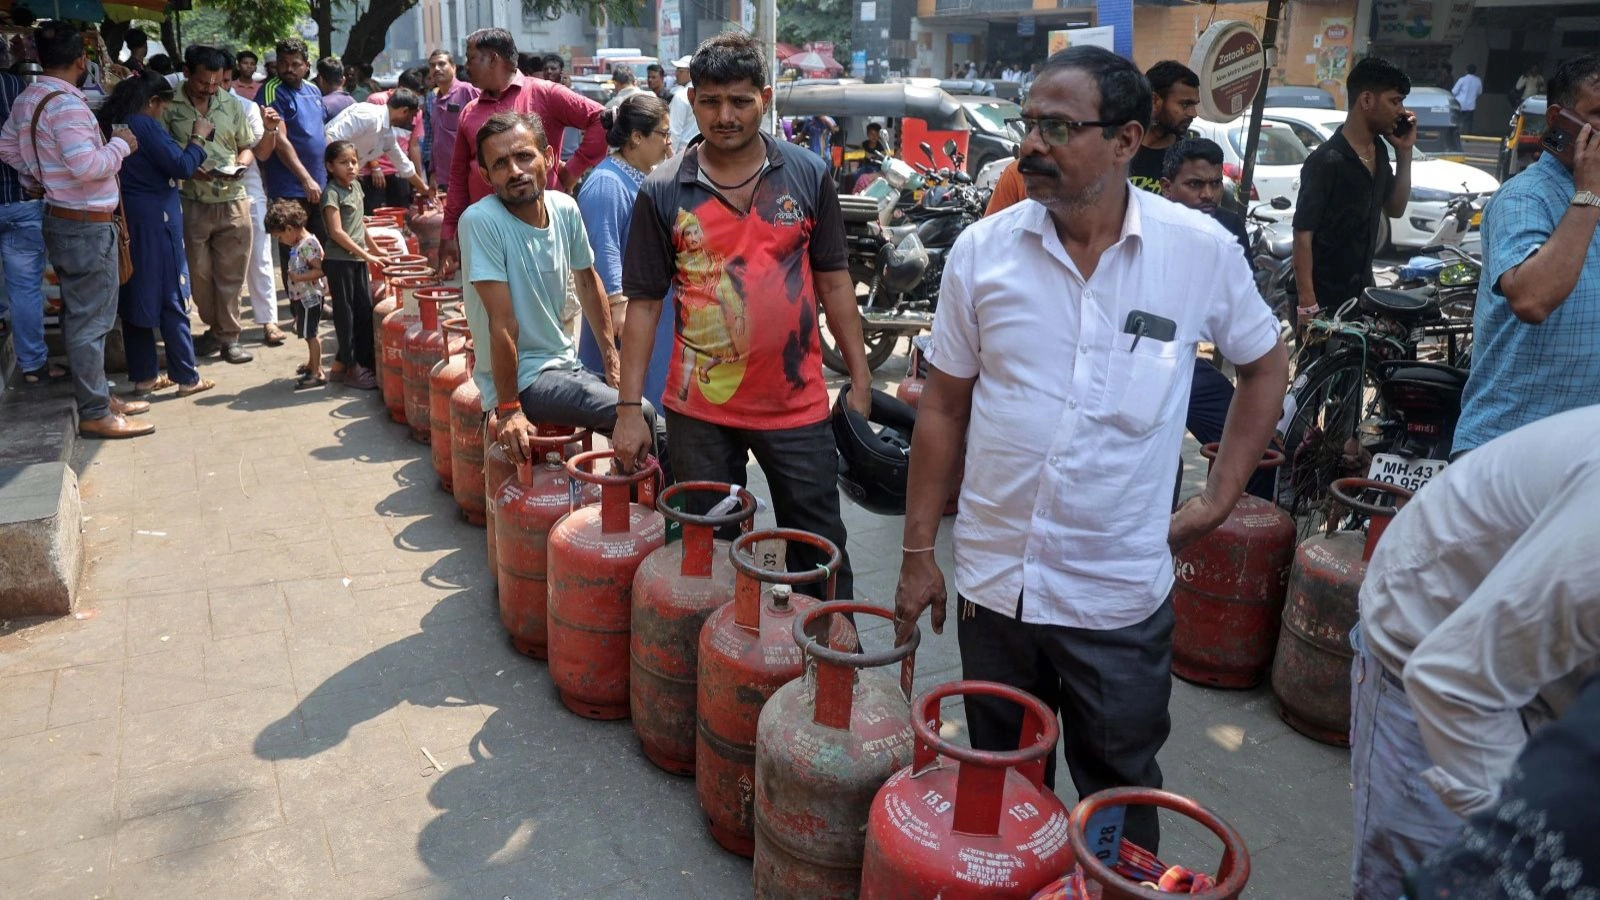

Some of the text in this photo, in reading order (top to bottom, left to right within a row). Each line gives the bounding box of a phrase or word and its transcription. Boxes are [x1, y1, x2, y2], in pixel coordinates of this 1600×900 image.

[1383, 461, 1433, 479] MH.43
[922, 790, 951, 813] 15.9
[1009, 802, 1039, 822] 15.9
[968, 862, 995, 874] SWITCH
[978, 879, 993, 887] NOT
